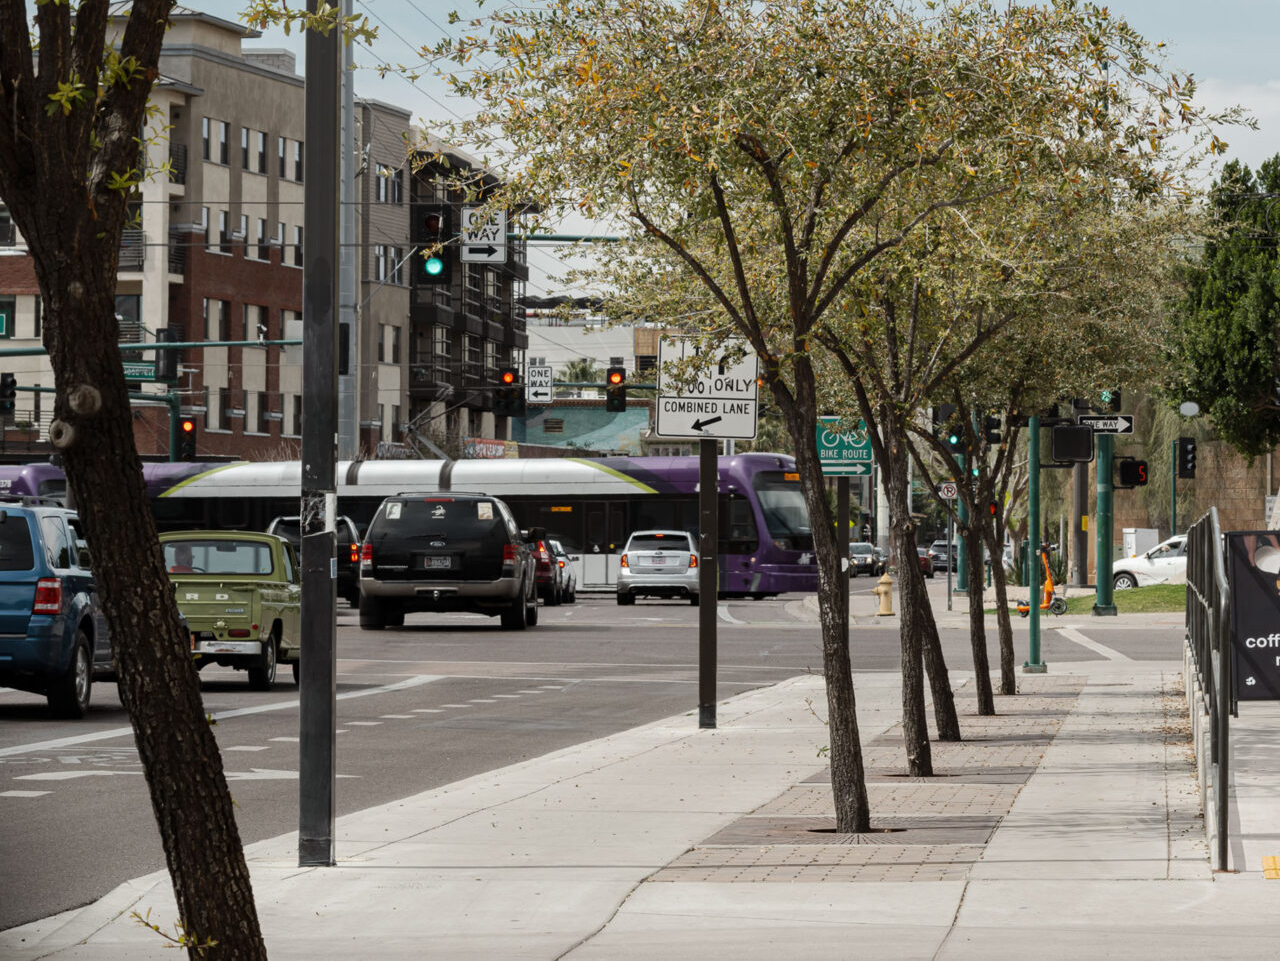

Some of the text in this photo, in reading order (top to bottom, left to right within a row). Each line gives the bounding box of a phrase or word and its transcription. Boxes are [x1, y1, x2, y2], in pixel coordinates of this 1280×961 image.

[467, 228, 500, 241] WAY
[531, 369, 550, 378] ONE
[530, 379, 550, 388] WAY
[714, 378, 752, 392] ONLY
[664, 401, 750, 415] COMBINED LANE
[820, 450, 868, 459] BIKE ROUTE
[1138, 465, 1146, 482] 5
